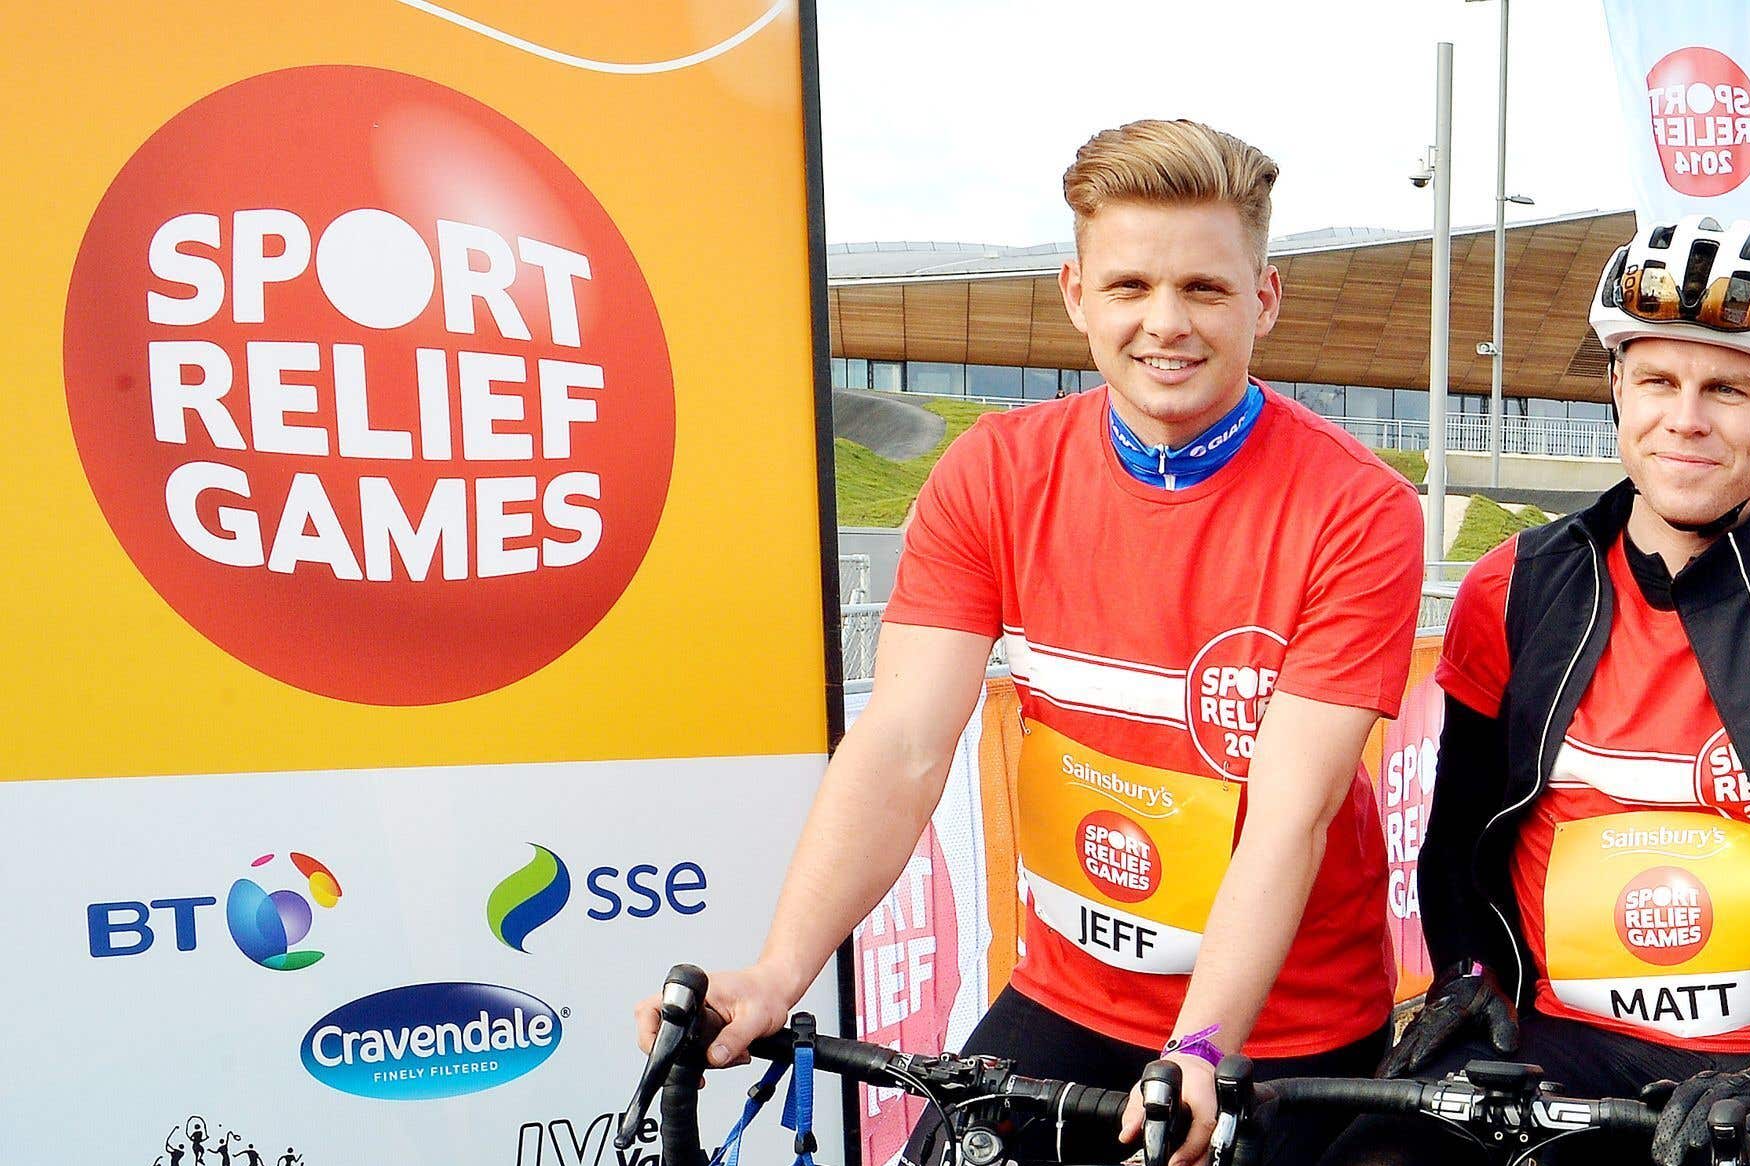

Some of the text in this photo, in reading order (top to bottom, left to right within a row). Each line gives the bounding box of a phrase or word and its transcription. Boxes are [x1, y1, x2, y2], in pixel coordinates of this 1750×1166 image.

[147, 208, 592, 346] SPORT
[147, 340, 605, 461] RELIEF
[164, 461, 604, 582] GAMES
[1061, 753, 1174, 809] Sainsbury's
[1084, 840, 1152, 875] RELIEF
[1085, 824, 1151, 861] SPORT
[1601, 825, 1728, 851] Sainsbury's
[587, 861, 708, 919] sse
[1085, 857, 1151, 891] GAMES
[1625, 886, 1699, 910] SPORT
[88, 896, 217, 958] BT
[1078, 905, 1158, 959] JEFF
[1625, 907, 1702, 930] RELIEF
[1628, 927, 1702, 949] GAMES
[1610, 983, 1738, 1022] MATT
[312, 1008, 553, 1067] Cravendale
[374, 1061, 499, 1082] FINELY FILTERED
